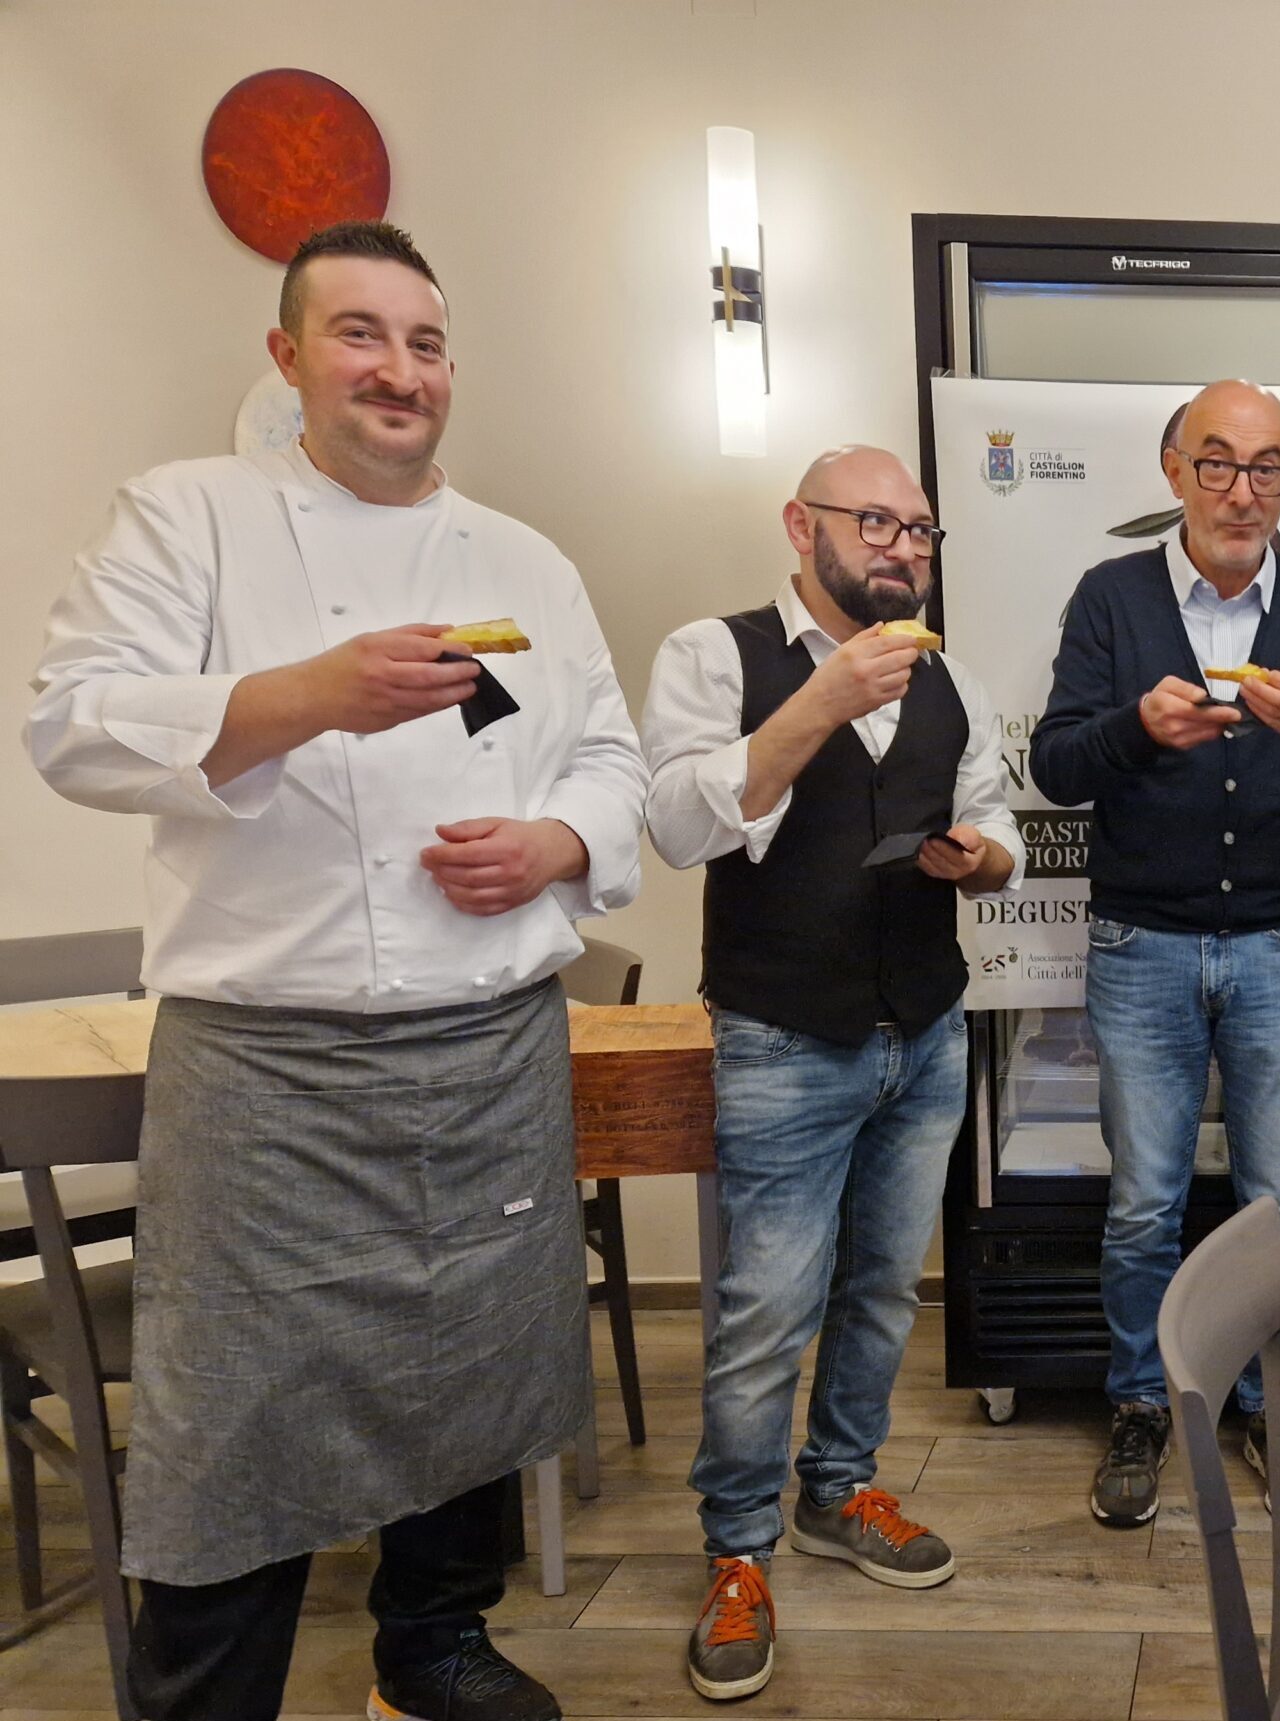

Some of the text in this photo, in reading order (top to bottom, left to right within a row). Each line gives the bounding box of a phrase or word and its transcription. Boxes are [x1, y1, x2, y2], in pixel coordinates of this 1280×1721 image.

[1128, 259, 1191, 269] TECFRIGO
[1054, 452, 1063, 461] di
[1030, 461, 1085, 471] CASTIGLION
[1030, 471, 1086, 480] FIORENTINO
[1028, 966, 1057, 980] Città
